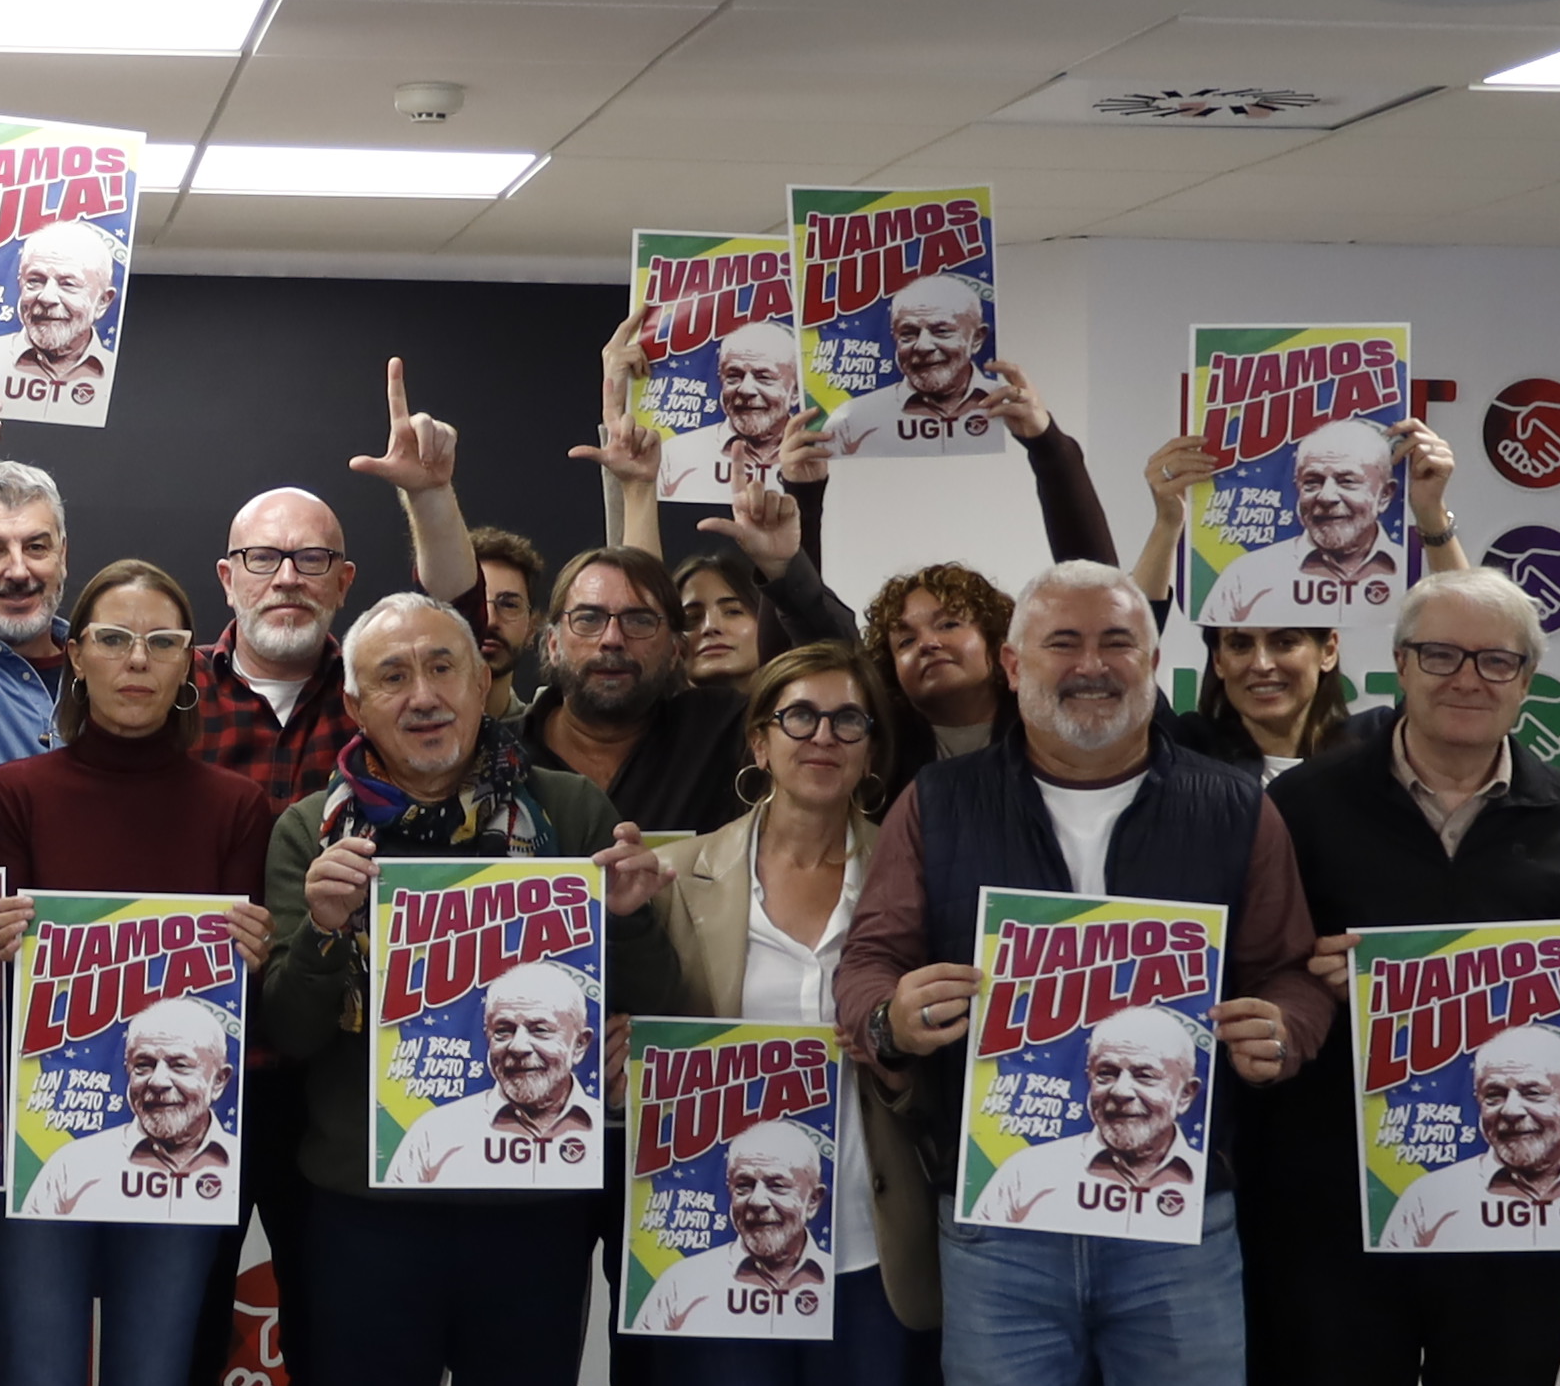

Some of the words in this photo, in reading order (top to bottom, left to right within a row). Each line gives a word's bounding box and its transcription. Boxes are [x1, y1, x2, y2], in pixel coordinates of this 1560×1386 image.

[803, 201, 978, 262] ¡VAMOS
[799, 225, 984, 331] LULA!
[638, 280, 793, 363] LULA
[842, 338, 881, 358] BRASIL
[836, 356, 875, 374] JUSTO
[1206, 340, 1396, 405] ¡VAMOS
[4, 376, 68, 403] UGT
[897, 416, 959, 441] UGT
[1200, 368, 1399, 473] LULA!
[1293, 580, 1359, 605] UGT
[388, 876, 588, 945] ¡VAMOS
[32, 914, 232, 978] ¡VAMOS
[992, 921, 1207, 979] ¡VAMOS
[380, 905, 593, 1023] LULA!
[21, 943, 236, 1055] LULA!
[977, 952, 1209, 1056] LULA!
[427, 1036, 471, 1058] BRASIL
[67, 1069, 111, 1092] BRASIL
[419, 1057, 464, 1078] JUSTO
[638, 1039, 827, 1100] ¡VAMOS
[58, 1089, 104, 1111] JUSTO
[1415, 1102, 1463, 1124] BRASIL
[632, 1066, 828, 1175] LULA!
[1408, 1123, 1456, 1144] JUSTO
[484, 1137, 553, 1164] UGT
[121, 1171, 190, 1198] UGT
[1076, 1181, 1151, 1214] UGT
[1480, 1200, 1553, 1228] UGT
[727, 1288, 790, 1315] UGT
